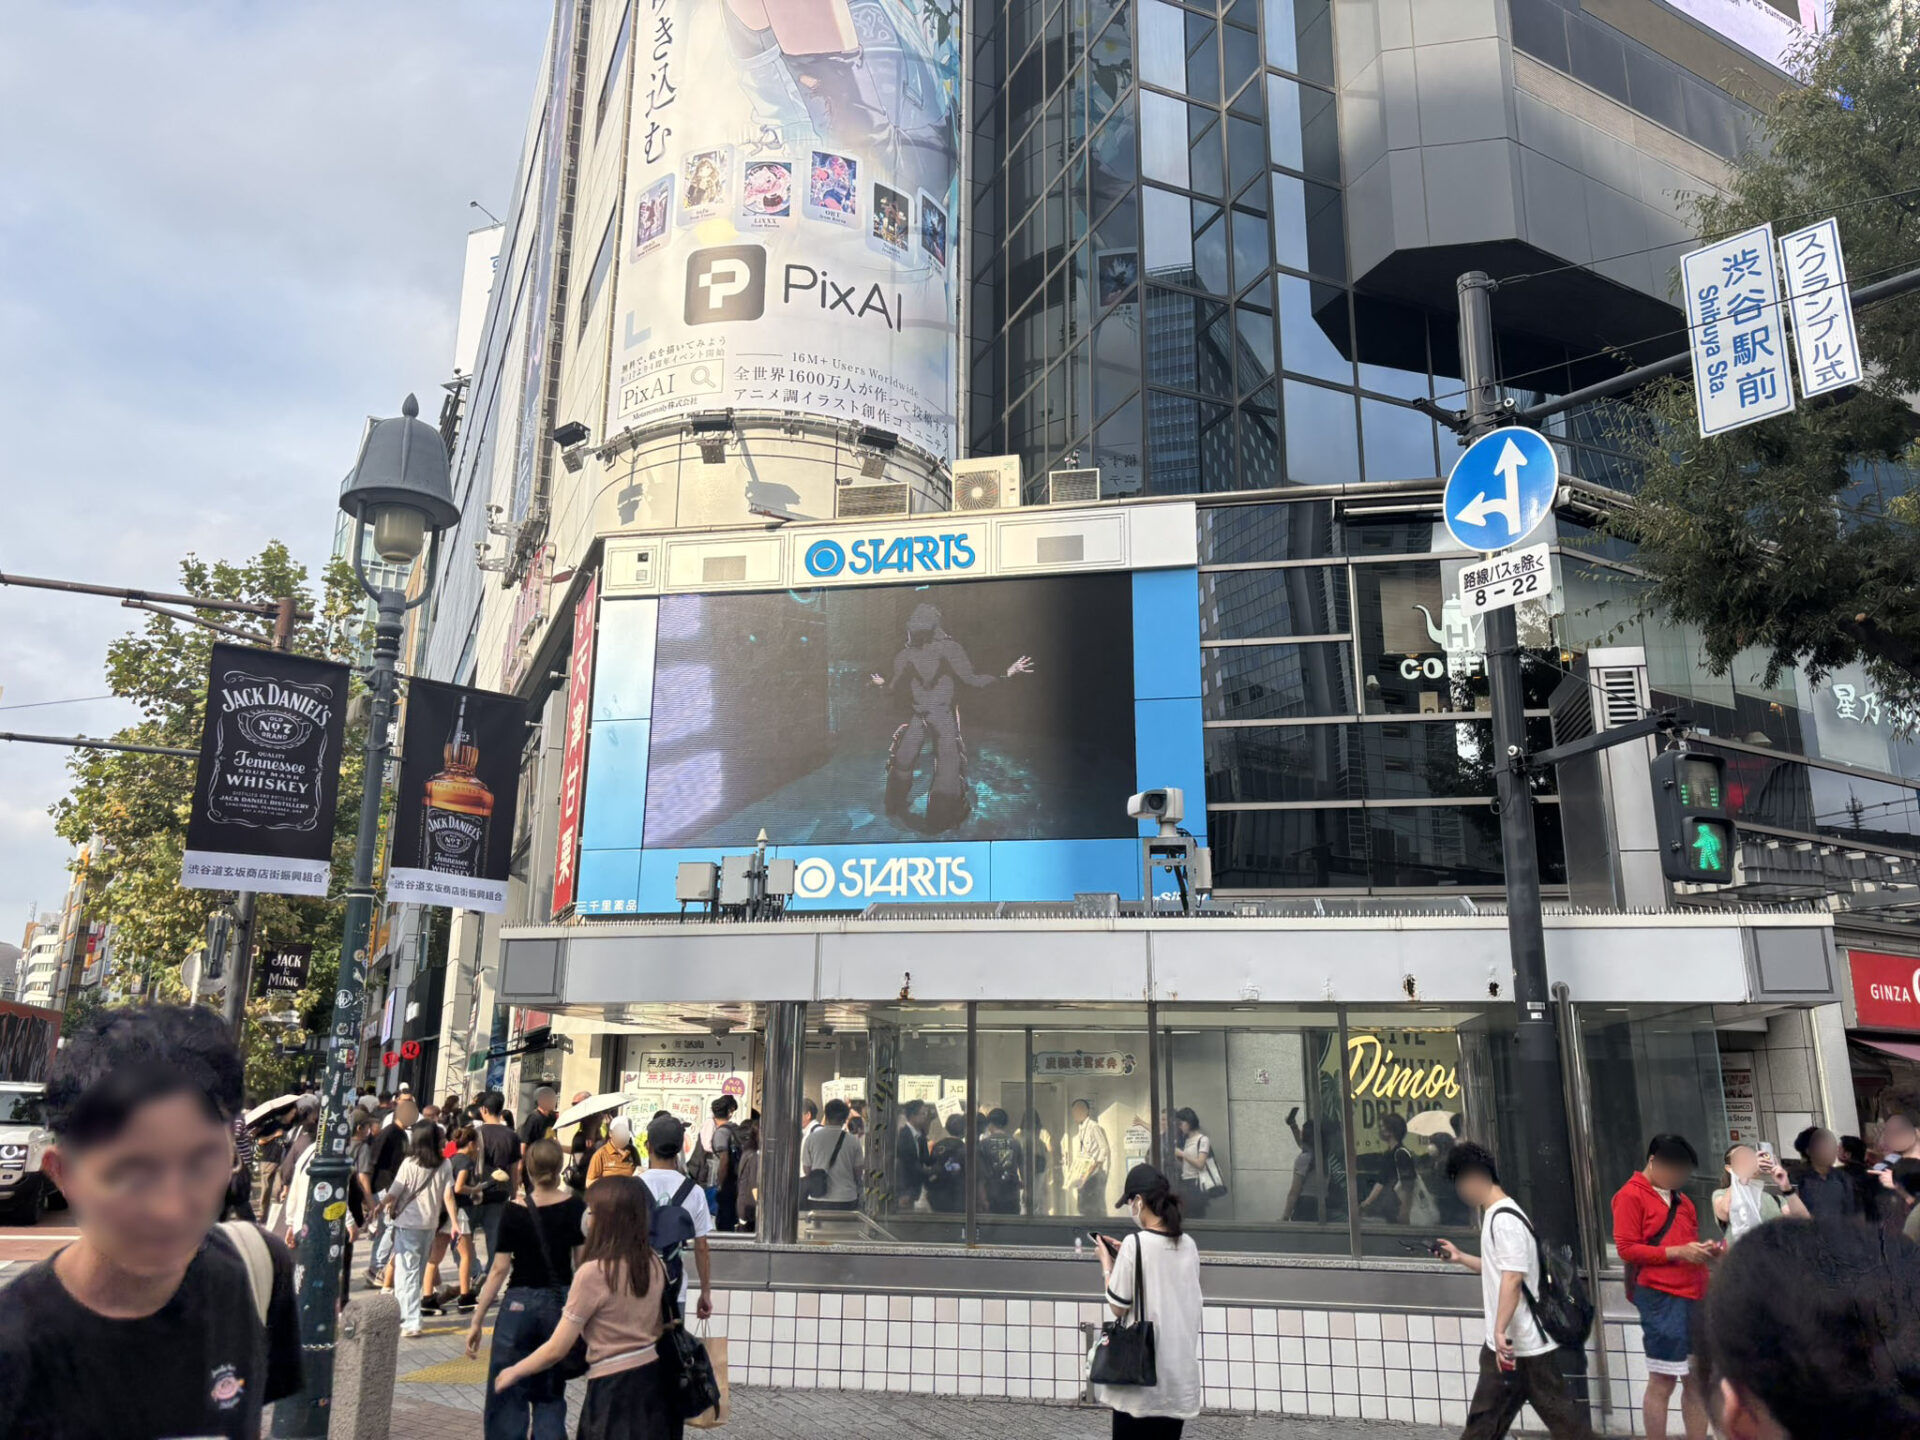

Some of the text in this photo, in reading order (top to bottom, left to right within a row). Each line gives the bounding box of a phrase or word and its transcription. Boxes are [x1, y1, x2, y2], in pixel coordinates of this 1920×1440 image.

[783, 263, 903, 332] PixAI
[1795, 232, 1848, 387] スクランブル式
[1698, 284, 1729, 399] Shibuya Sta.
[1721, 248, 1777, 409] 渋谷駅前
[793, 351, 919, 399] 16M+ Users Worldwide
[623, 373, 676, 411] PixAI
[1463, 553, 1545, 590] 路線バスを除く
[221, 682, 332, 727] JACK DANIEL'S
[233, 750, 306, 775] Tennessee
[226, 773, 309, 794] WHISKEY
[428, 815, 482, 841] JACK DANIEL'S
[187, 863, 324, 883] 渋谷道玄坂商店街振興組合
[392, 879, 504, 902] 渋谷道玄坂商店街振興組合
[575, 899, 637, 913] 三千里薬品
[271, 954, 302, 968] JACK
[267, 972, 300, 987] MUSIC
[1870, 983, 1912, 1003] GINZA
